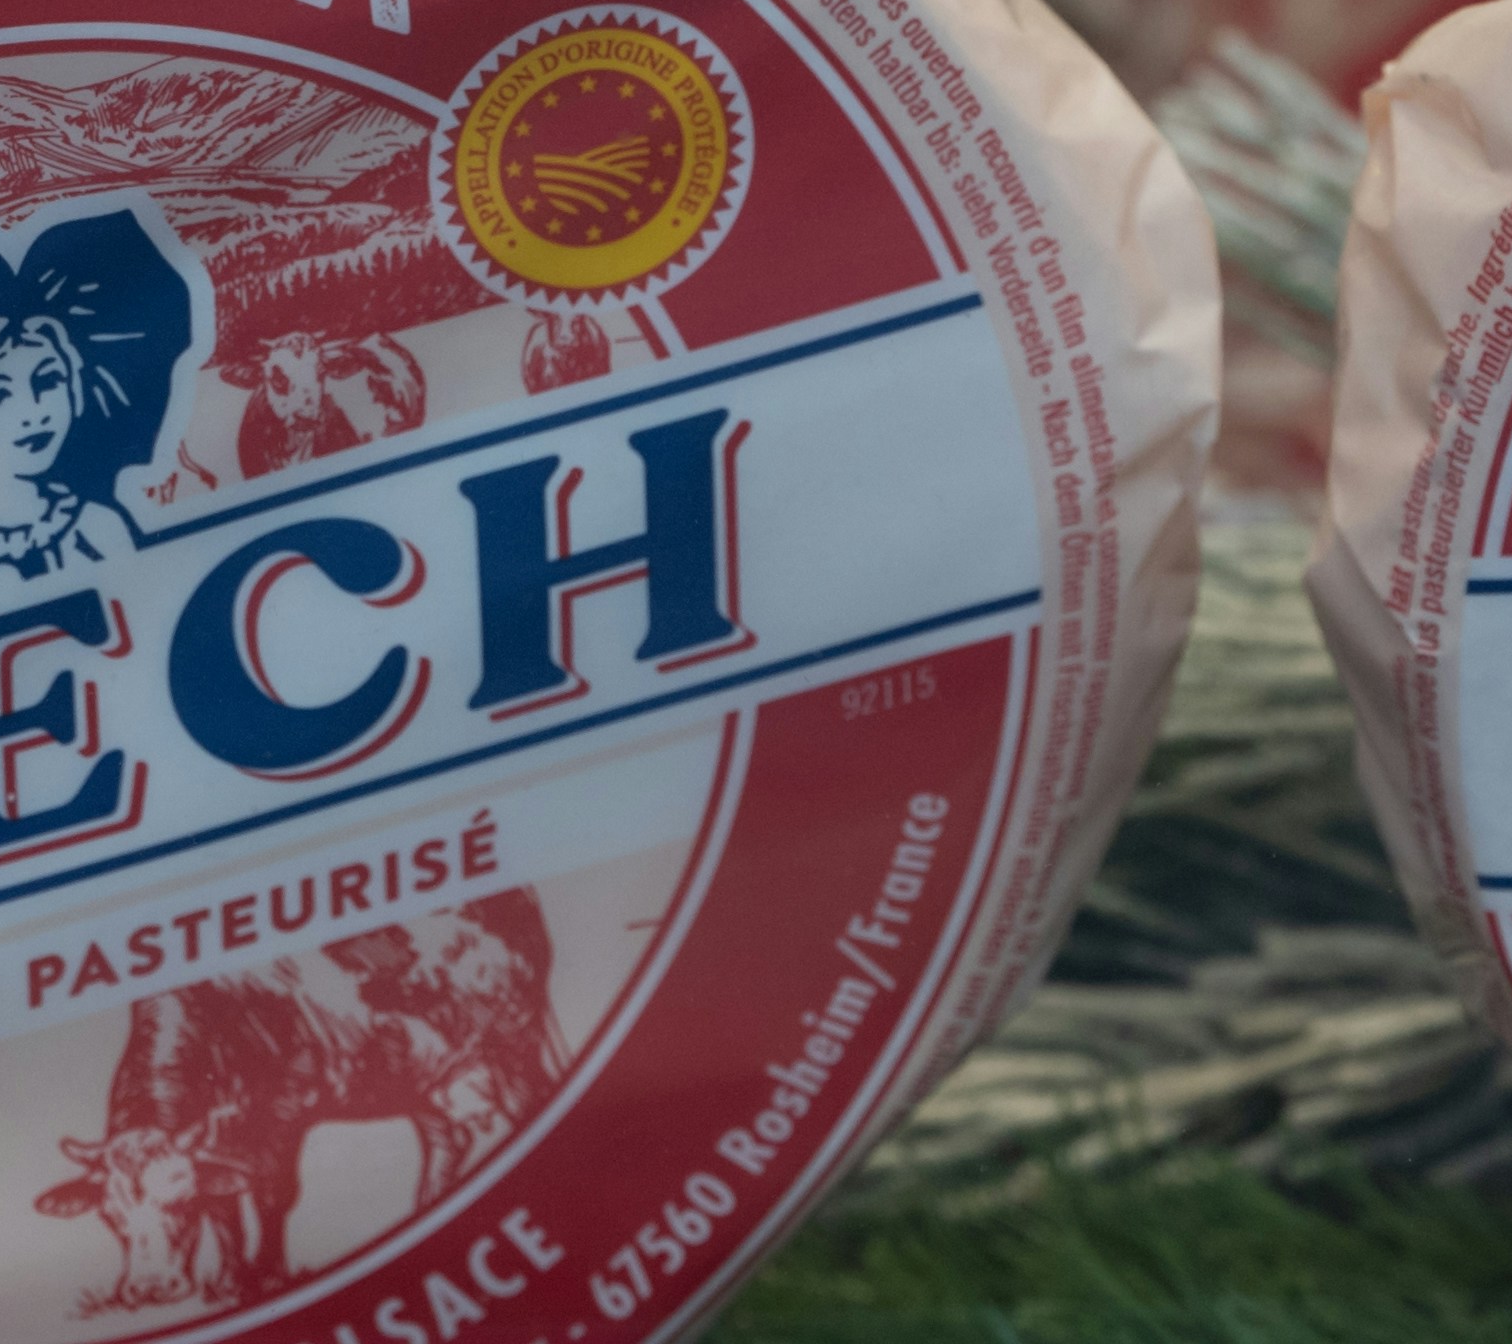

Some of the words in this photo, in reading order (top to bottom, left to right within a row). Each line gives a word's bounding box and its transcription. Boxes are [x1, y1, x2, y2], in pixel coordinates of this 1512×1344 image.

[467, 67, 536, 238] APPELLATION
[539, 39, 680, 80] D'ORIGINE
[673, 74, 720, 216] PROTÉGÉE
[868, 39, 938, 126] haltbar
[953, 174, 999, 240] siehe
[901, 17, 982, 132] ouverture,
[976, 128, 1044, 232] recouvrir
[26, 808, 504, 1009] PASTEURISÉ
[589, 1172, 737, 1320] 67560
[717, 793, 949, 1176] Rosheim/France
